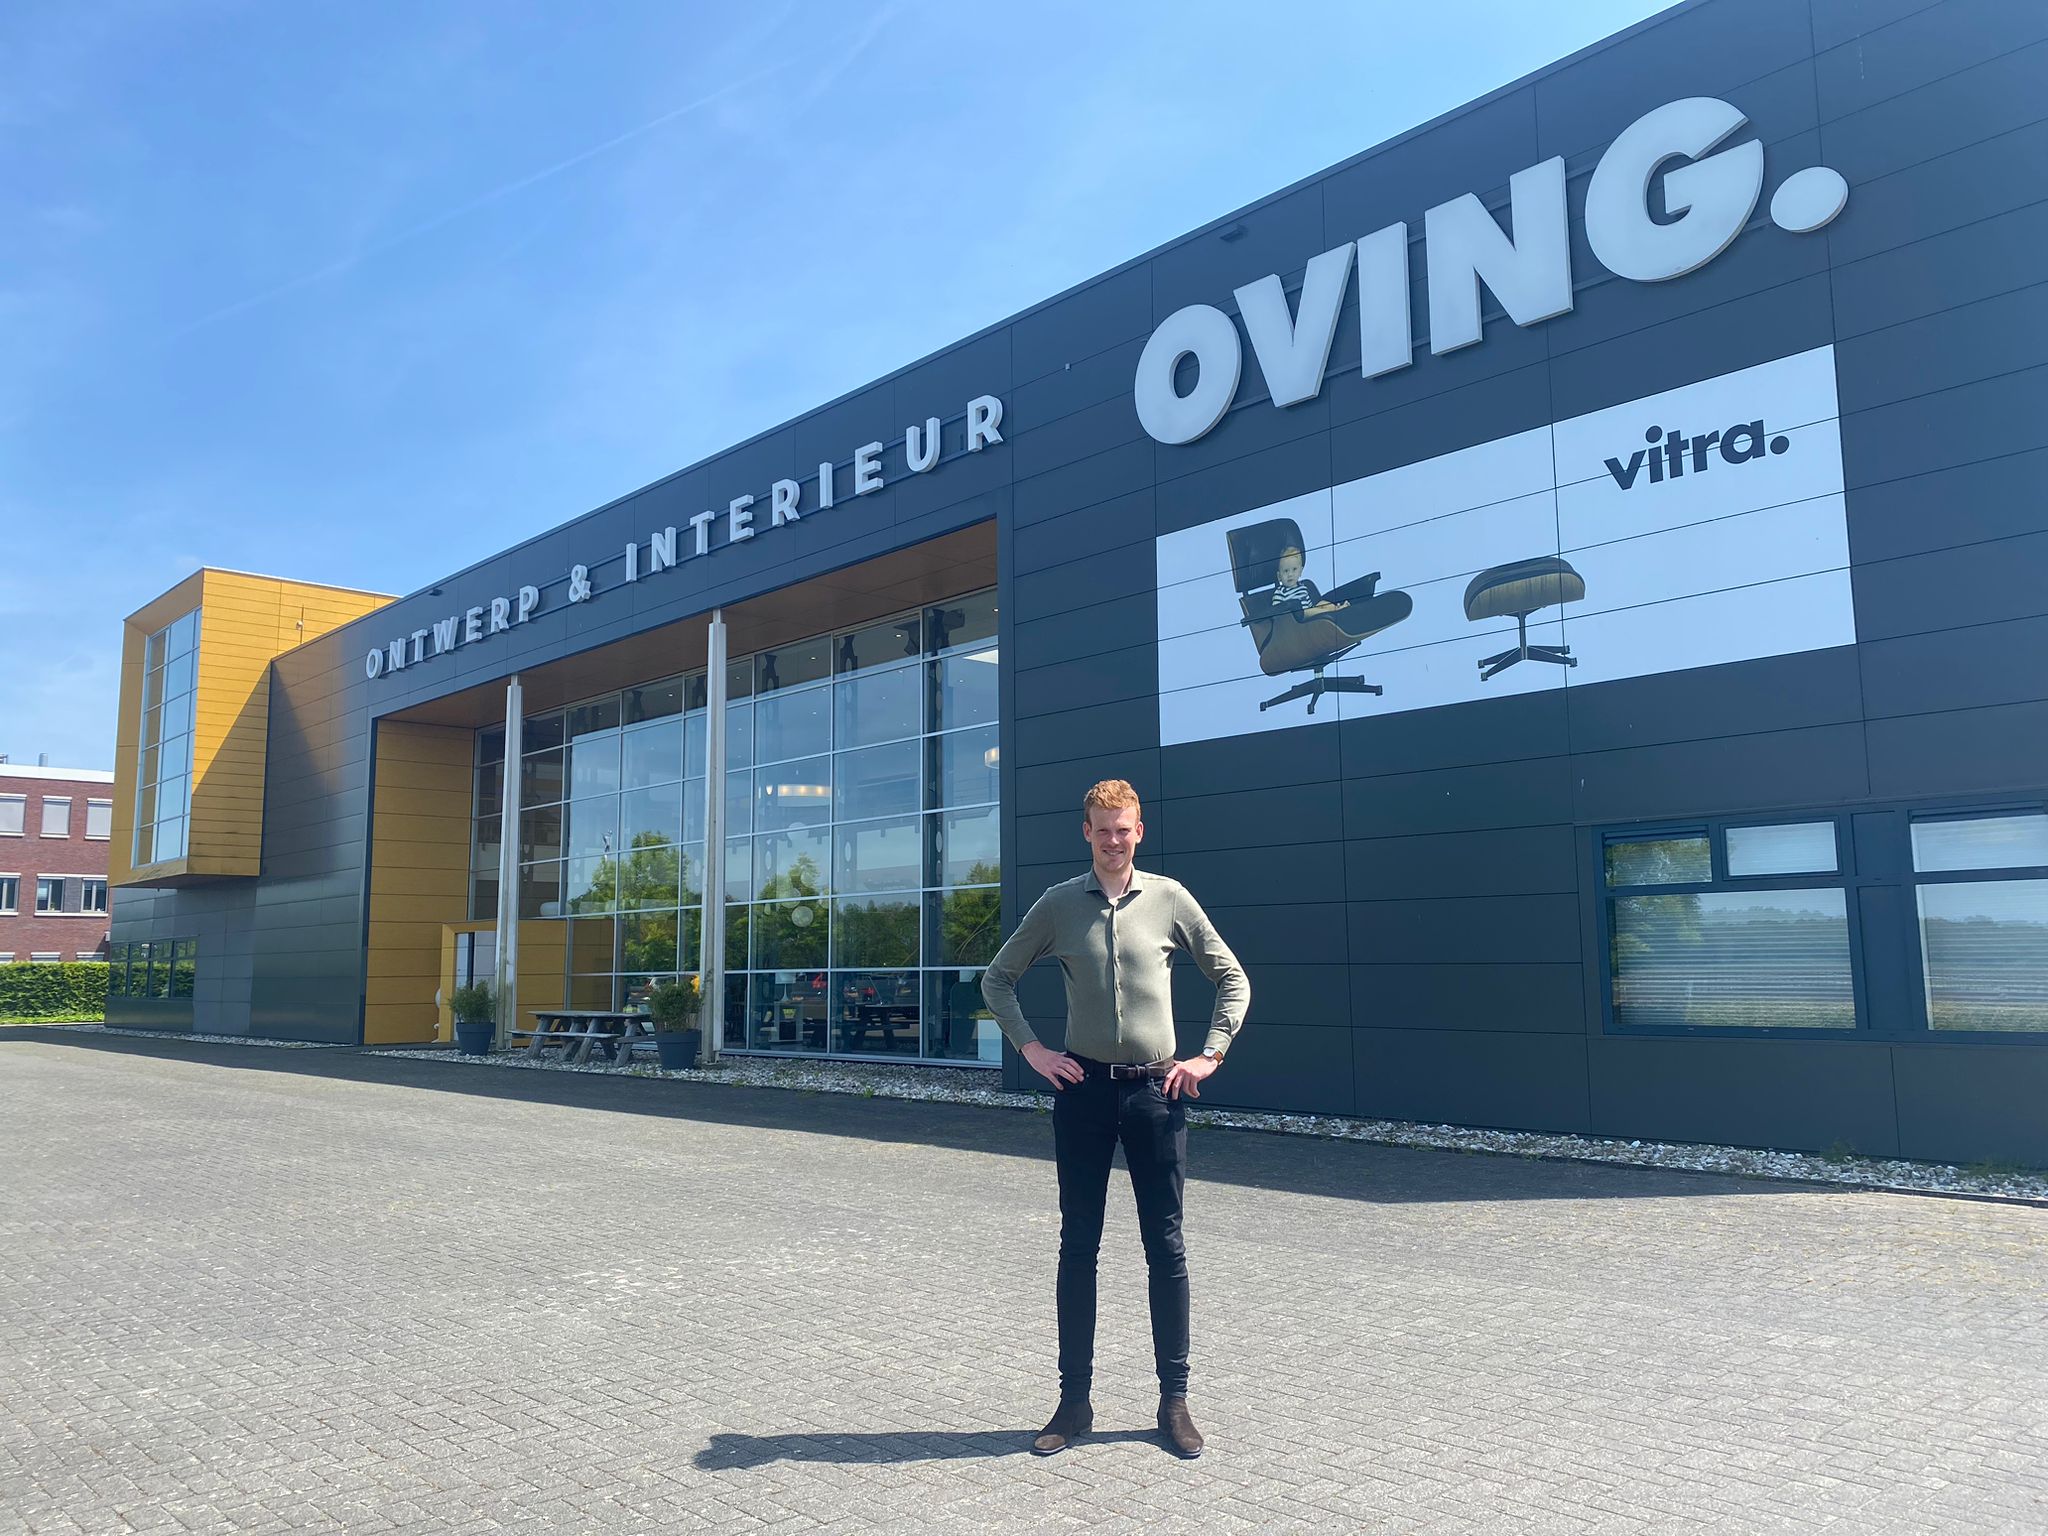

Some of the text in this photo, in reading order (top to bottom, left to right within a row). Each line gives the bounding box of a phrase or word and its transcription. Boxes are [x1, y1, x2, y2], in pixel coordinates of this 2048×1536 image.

[1134, 96, 1848, 445] OVING.
[365, 395, 1004, 680] ONTWERP & INTERIEUR
[1604, 419, 1790, 491] vitra.
